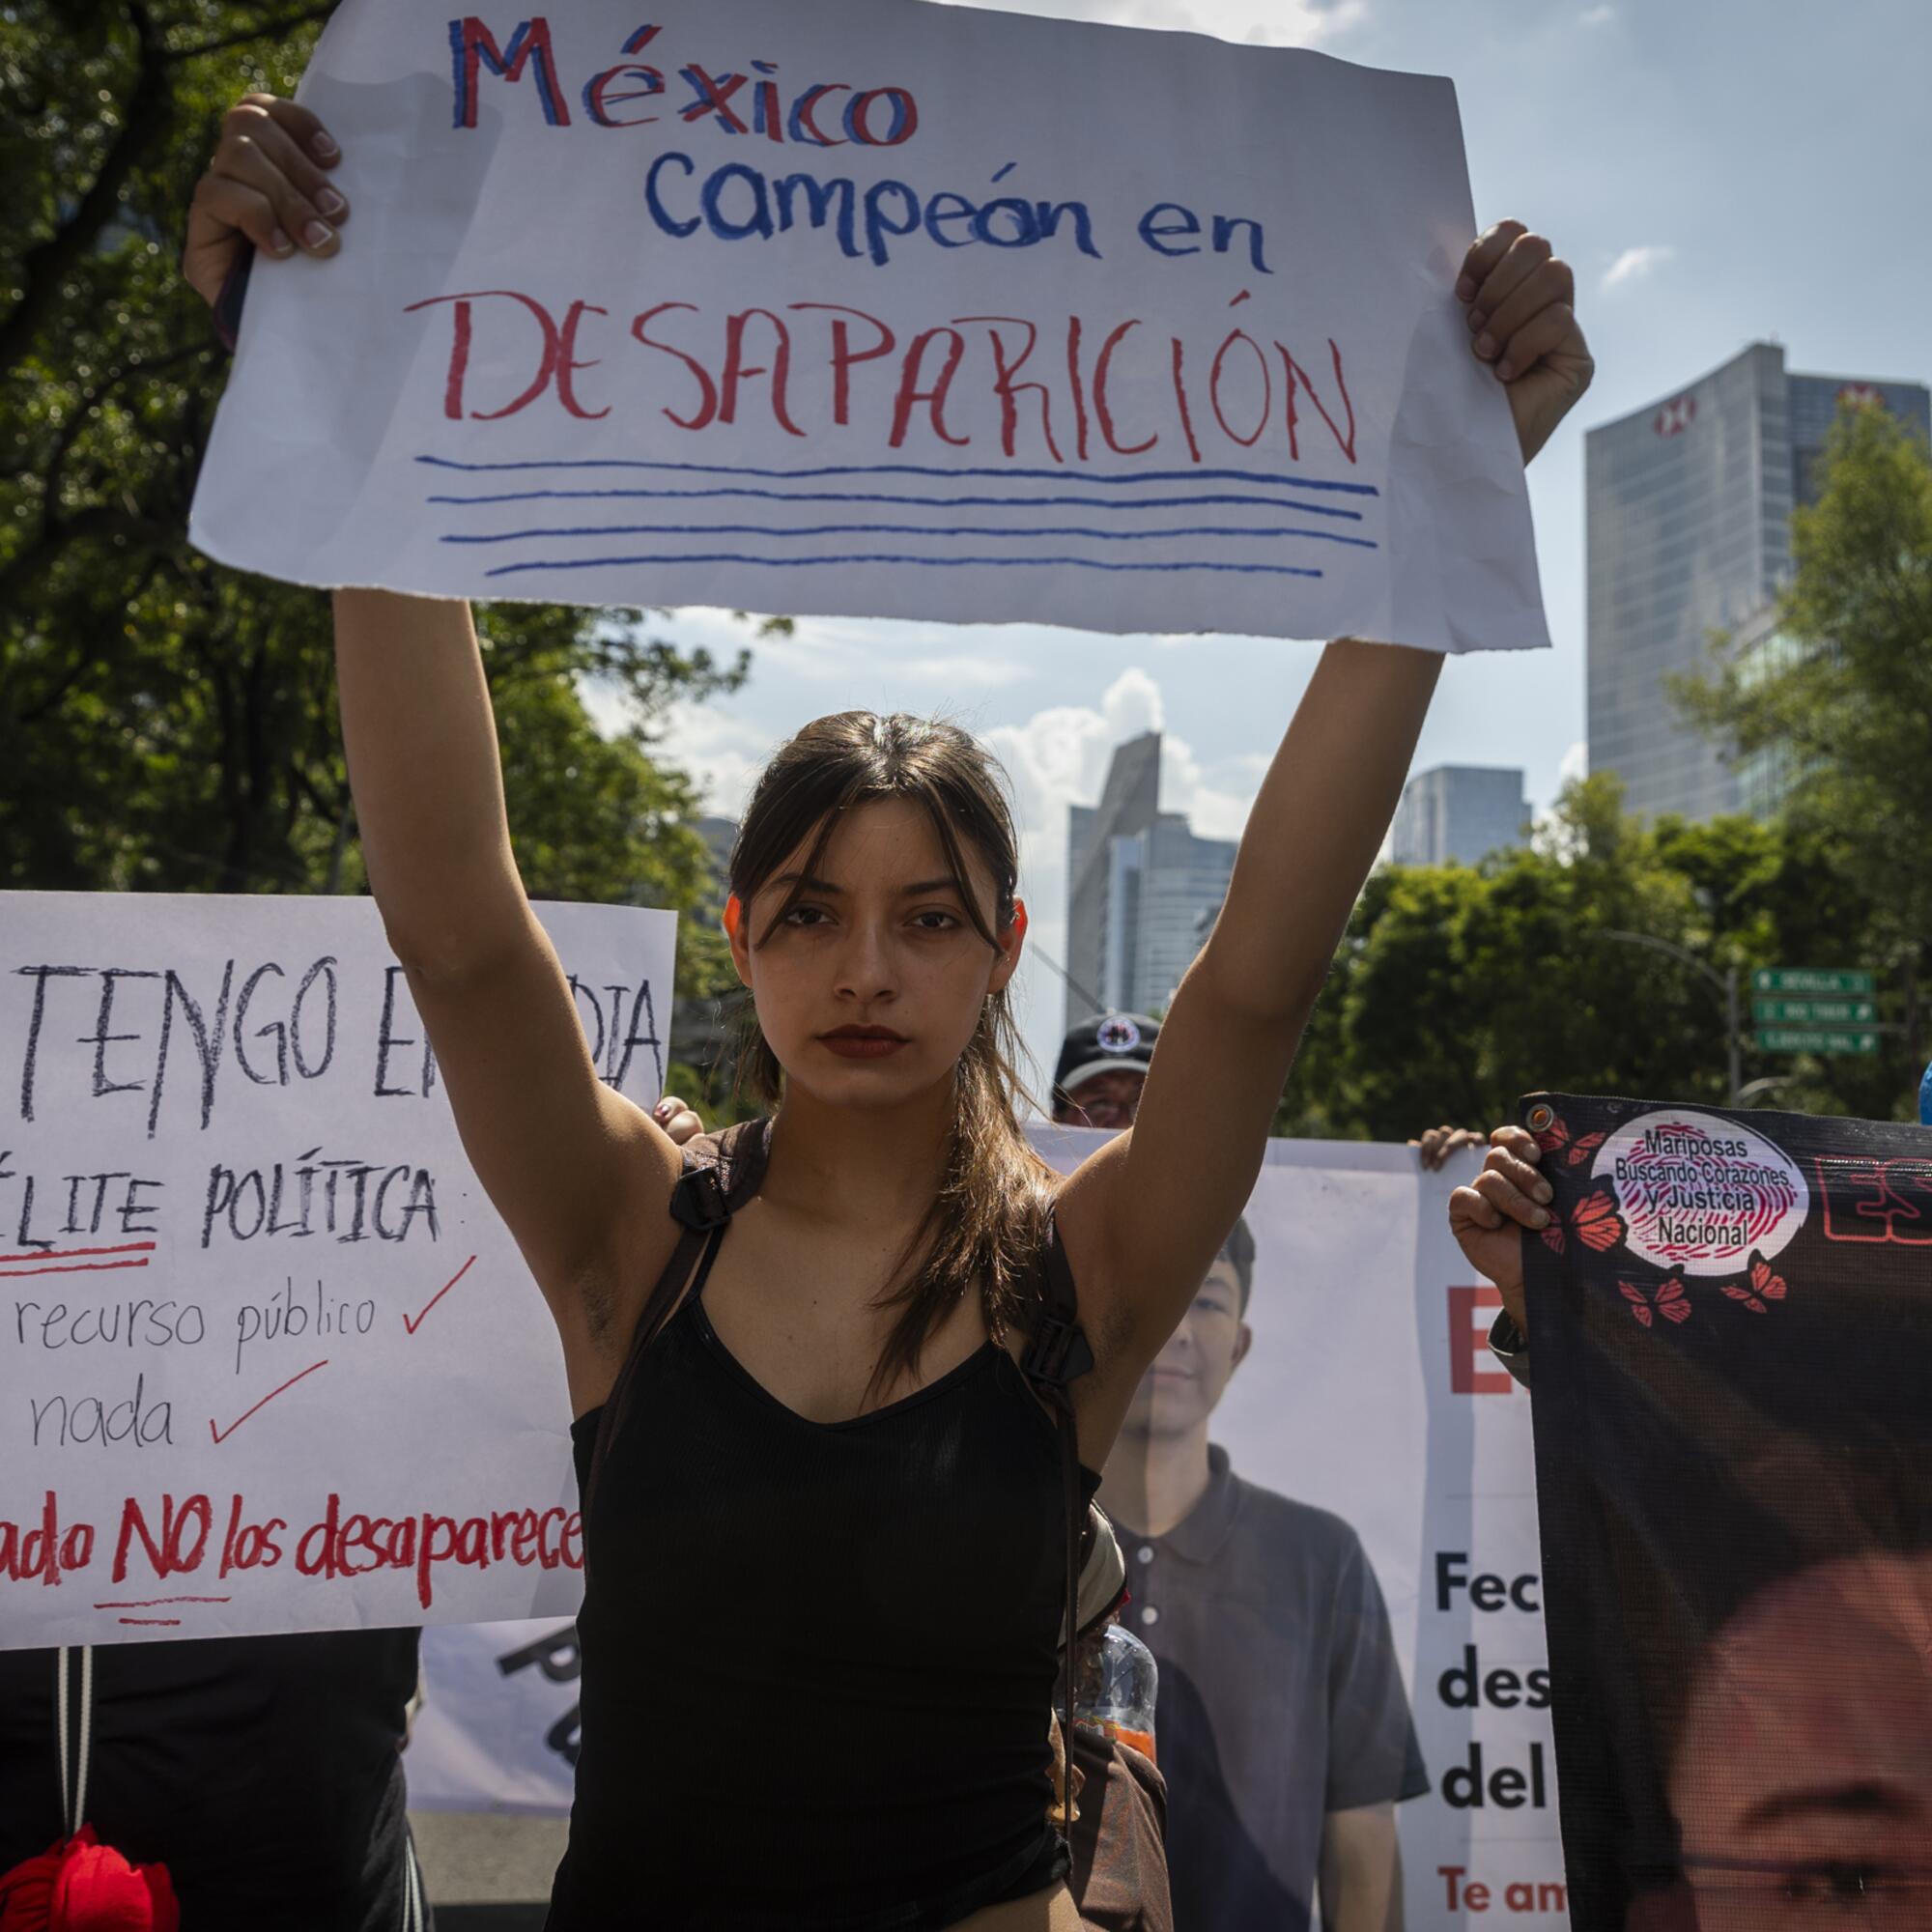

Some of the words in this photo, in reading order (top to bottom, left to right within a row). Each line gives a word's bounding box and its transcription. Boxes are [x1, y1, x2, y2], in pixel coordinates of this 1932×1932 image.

[448, 16, 918, 146] México
[1138, 203, 1273, 273] en
[403, 290, 1357, 464] DESAPARICIÓN
[14, 956, 337, 1139] TENGO
[1615, 1157, 1698, 1183] Buscando
[1701, 1161, 1789, 1186] Corazones
[1644, 1129, 1748, 1159] Mariposas
[0, 1151, 164, 1252] LITE
[1645, 1190, 1660, 1214] y
[1667, 1185, 1756, 1211] Justicia
[1659, 1216, 1747, 1246] Nacional
[15, 1299, 204, 1350] recurso
[237, 1276, 375, 1375] público
[31, 1373, 174, 1448] nada
[112, 1493, 213, 1583] NO
[219, 1493, 287, 1579] los
[1435, 1552, 1541, 1612] Fec
[1437, 1644, 1550, 1709] des
[1441, 1742, 1546, 1809] del
[1437, 1865, 1491, 1913] Te
